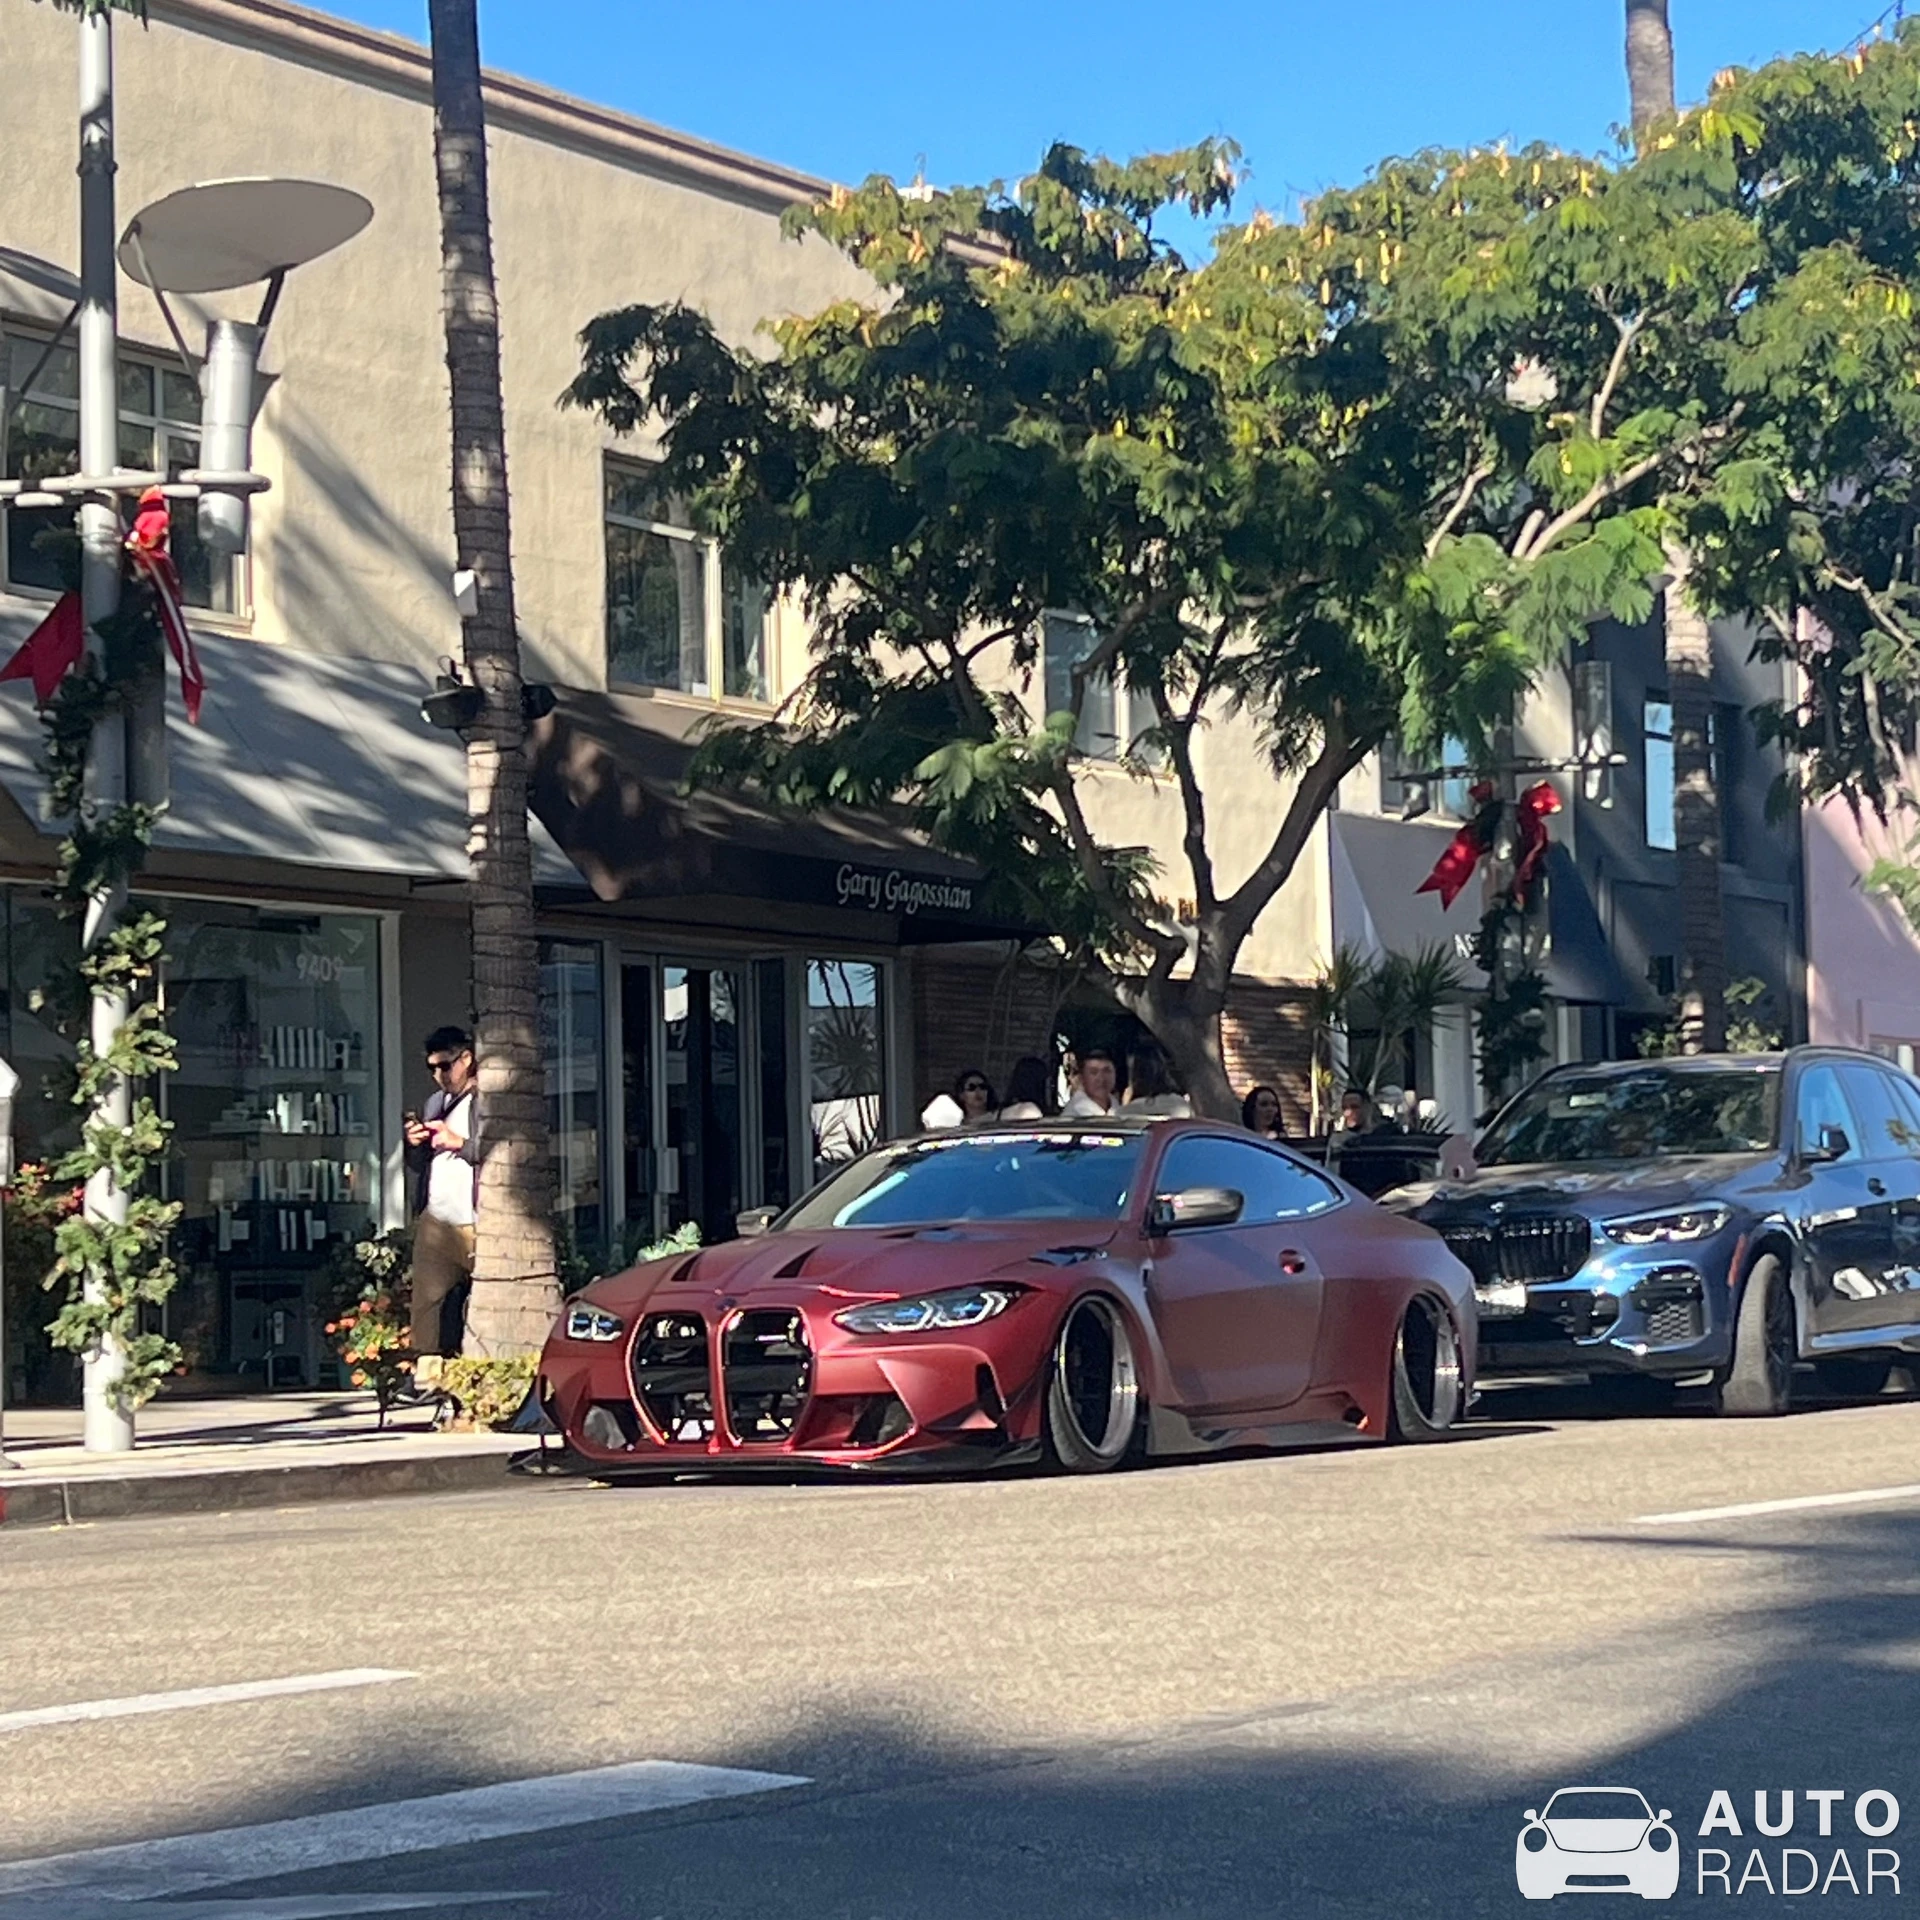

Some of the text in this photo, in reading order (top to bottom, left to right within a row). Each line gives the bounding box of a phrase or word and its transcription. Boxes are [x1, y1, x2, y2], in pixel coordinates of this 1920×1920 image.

[836, 863, 972, 915] Gary Gagossian
[296, 953, 343, 982] 9409
